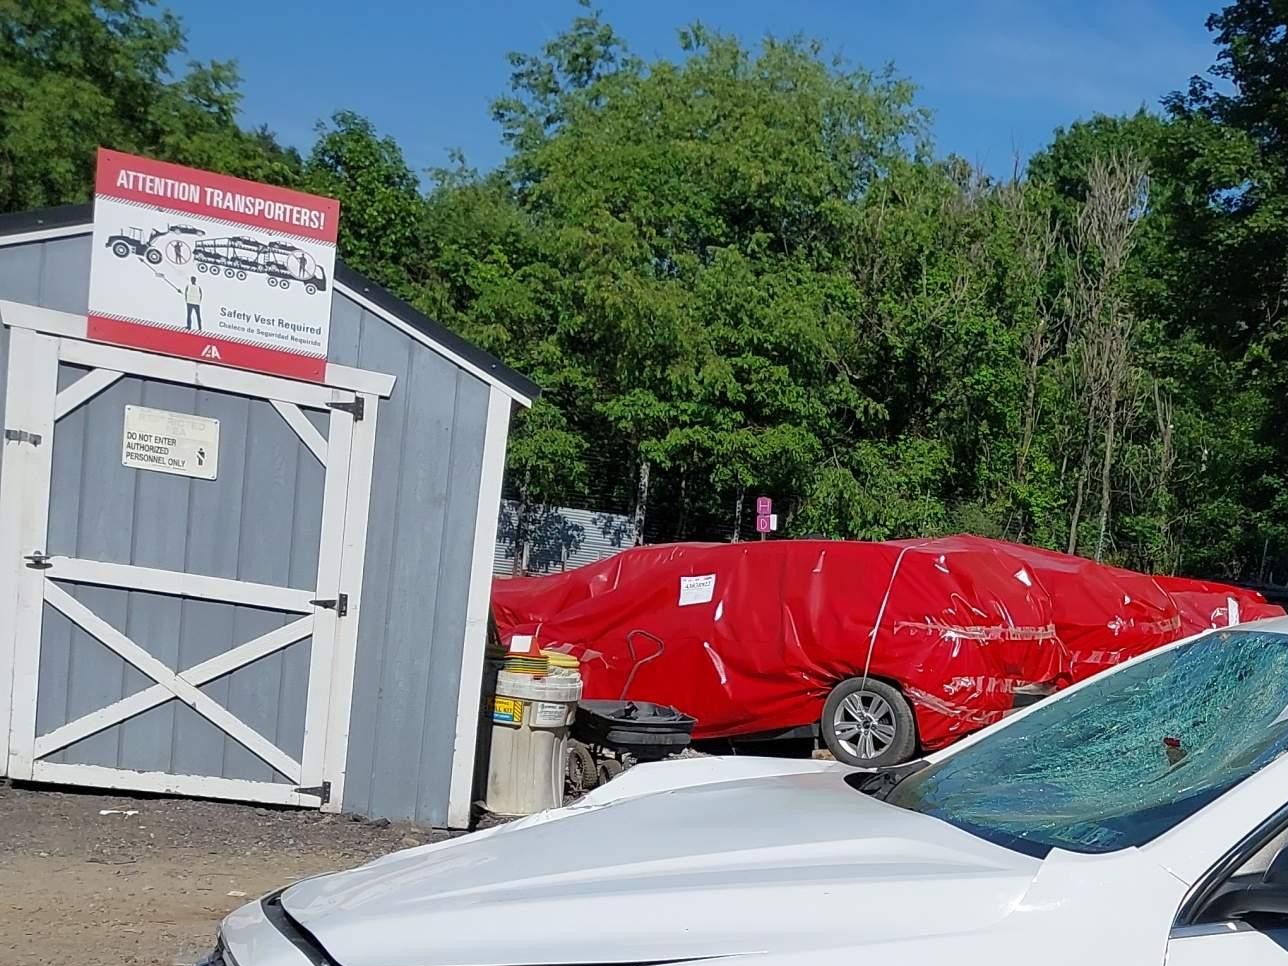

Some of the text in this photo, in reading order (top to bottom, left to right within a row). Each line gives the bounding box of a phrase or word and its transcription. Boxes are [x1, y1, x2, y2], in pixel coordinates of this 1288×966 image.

[116, 169, 325, 230] ATTENTION TRANSPORTERS!
[220, 307, 322, 335] Safety Vest Required
[218, 321, 246, 332] Chaleco
[256, 328, 289, 340] Seguridad
[126, 441, 170, 455] AUTHORIZED
[127, 431, 177, 447] DO NOT ENTER
[125, 451, 186, 468] PERSONNEL ONLY
